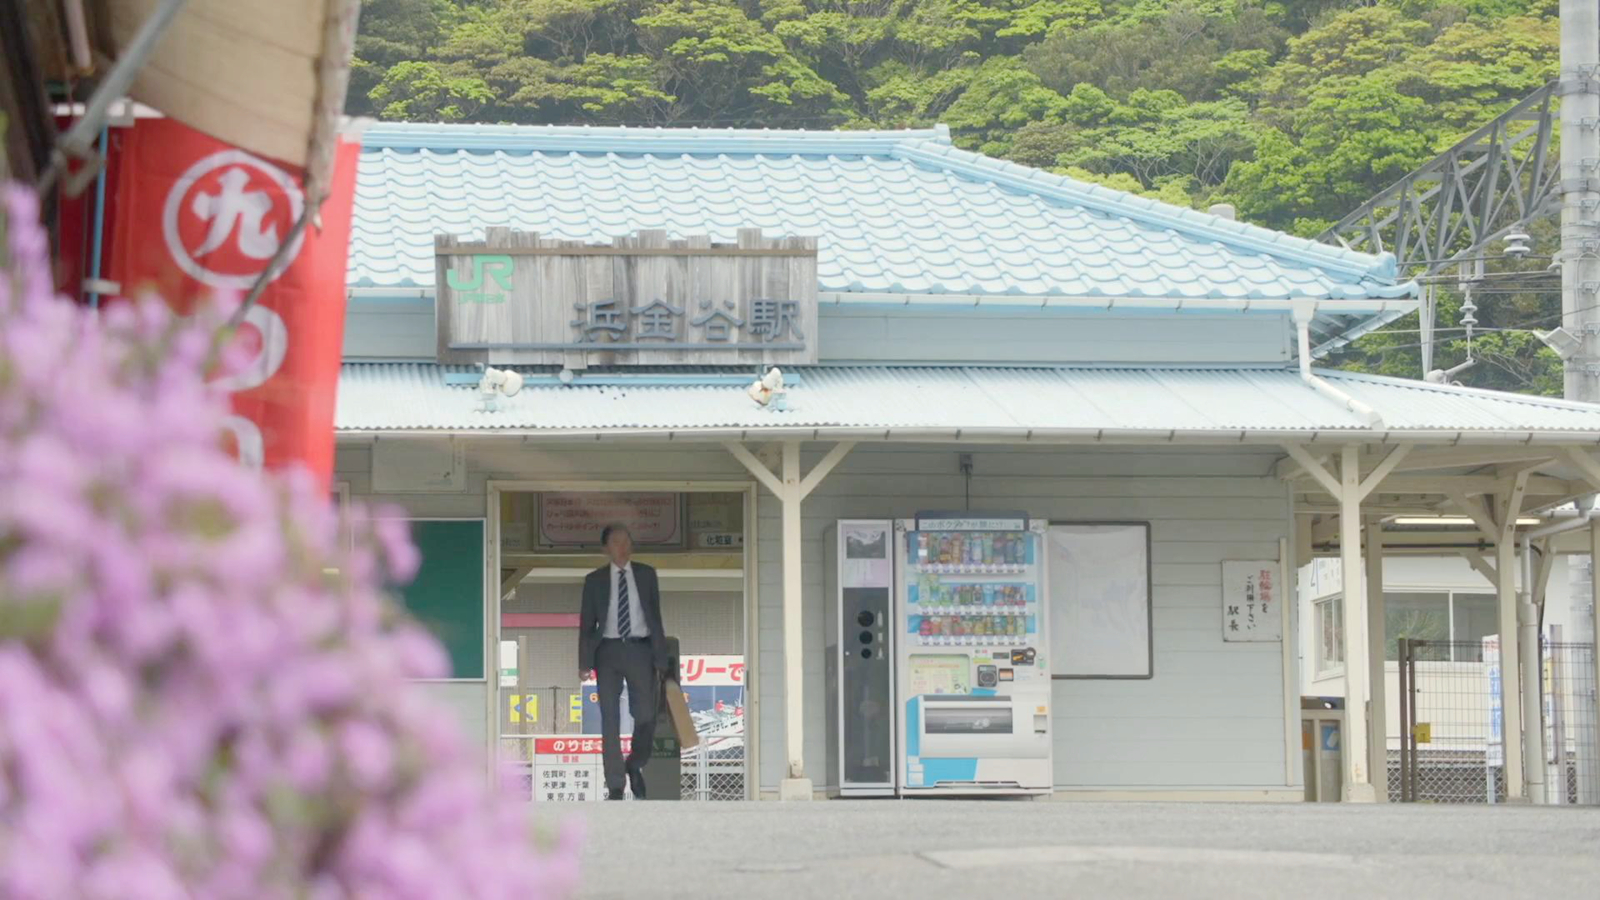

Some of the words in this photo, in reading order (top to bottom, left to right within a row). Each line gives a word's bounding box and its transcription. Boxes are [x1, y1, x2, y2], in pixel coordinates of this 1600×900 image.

[191, 166, 281, 260] 九
[446, 254, 514, 291] JR
[570, 298, 804, 343] 浜金谷駅
